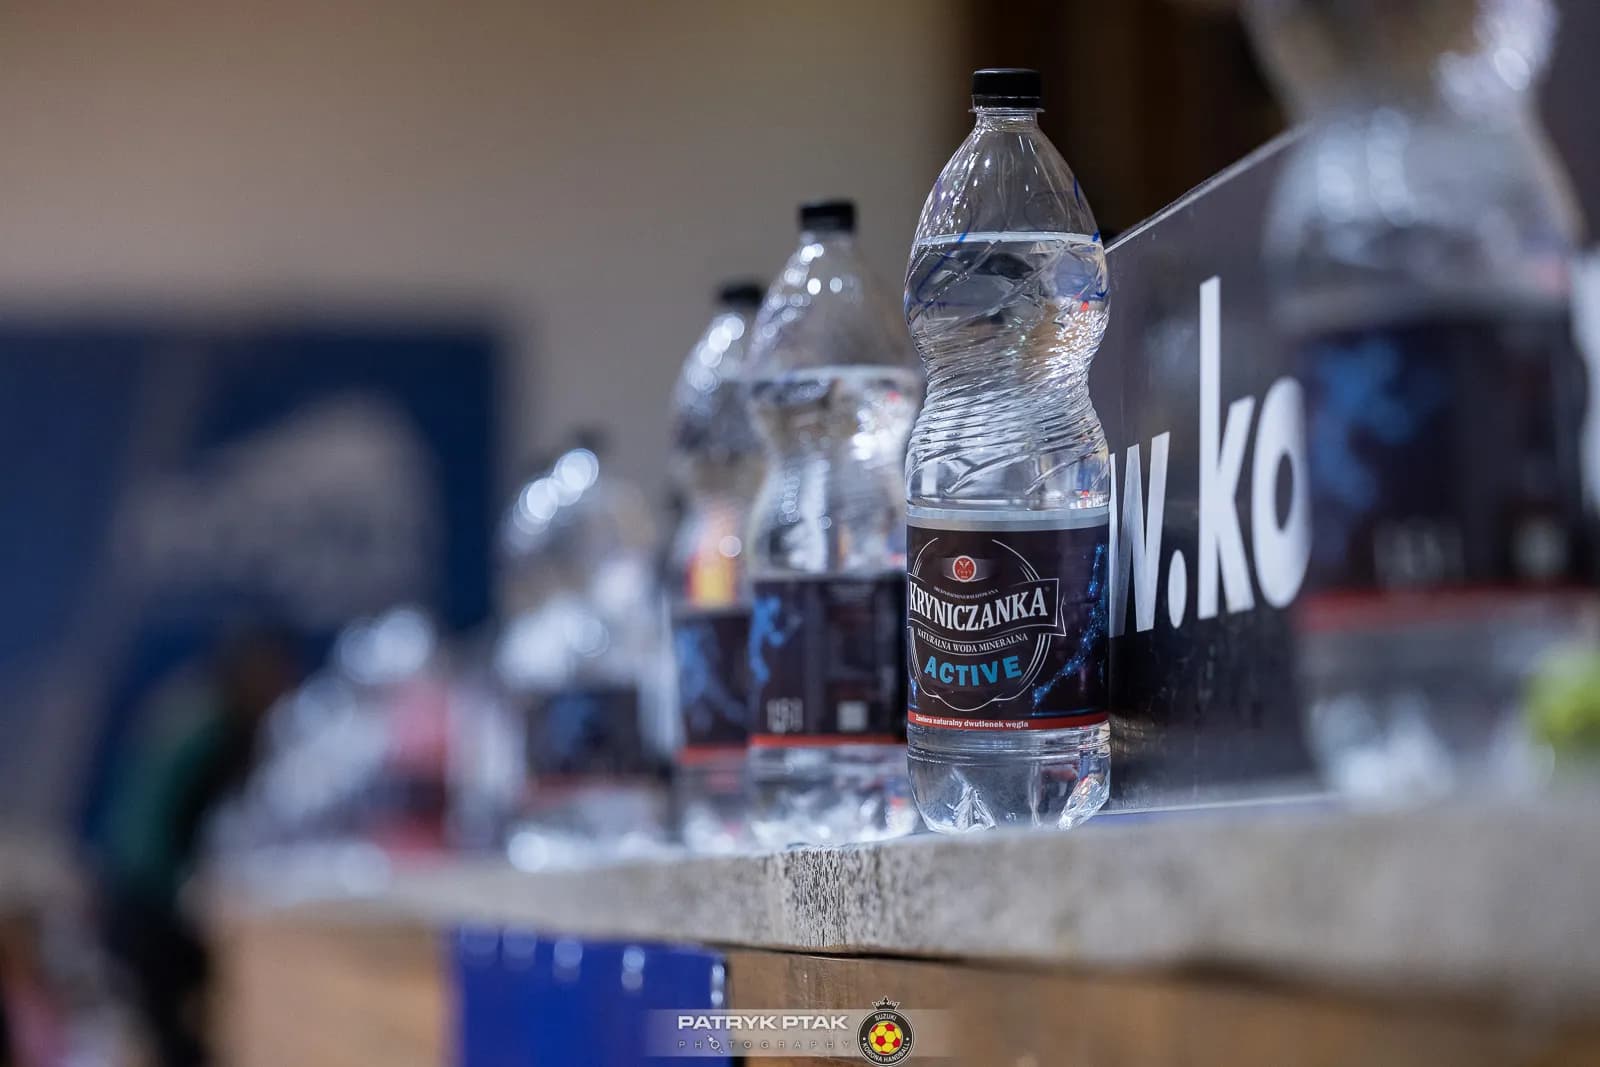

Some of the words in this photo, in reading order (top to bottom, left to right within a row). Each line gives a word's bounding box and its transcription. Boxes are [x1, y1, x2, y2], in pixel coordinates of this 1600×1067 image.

[909, 580, 1049, 631] KRYNICZANKA
[917, 627, 951, 651] NATURALNA
[952, 643, 978, 653] WODA
[979, 632, 1029, 652] MINERALNA
[924, 655, 1023, 687] ACTIVE
[933, 717, 962, 728] naturalny
[963, 719, 1003, 728] dwutlenek
